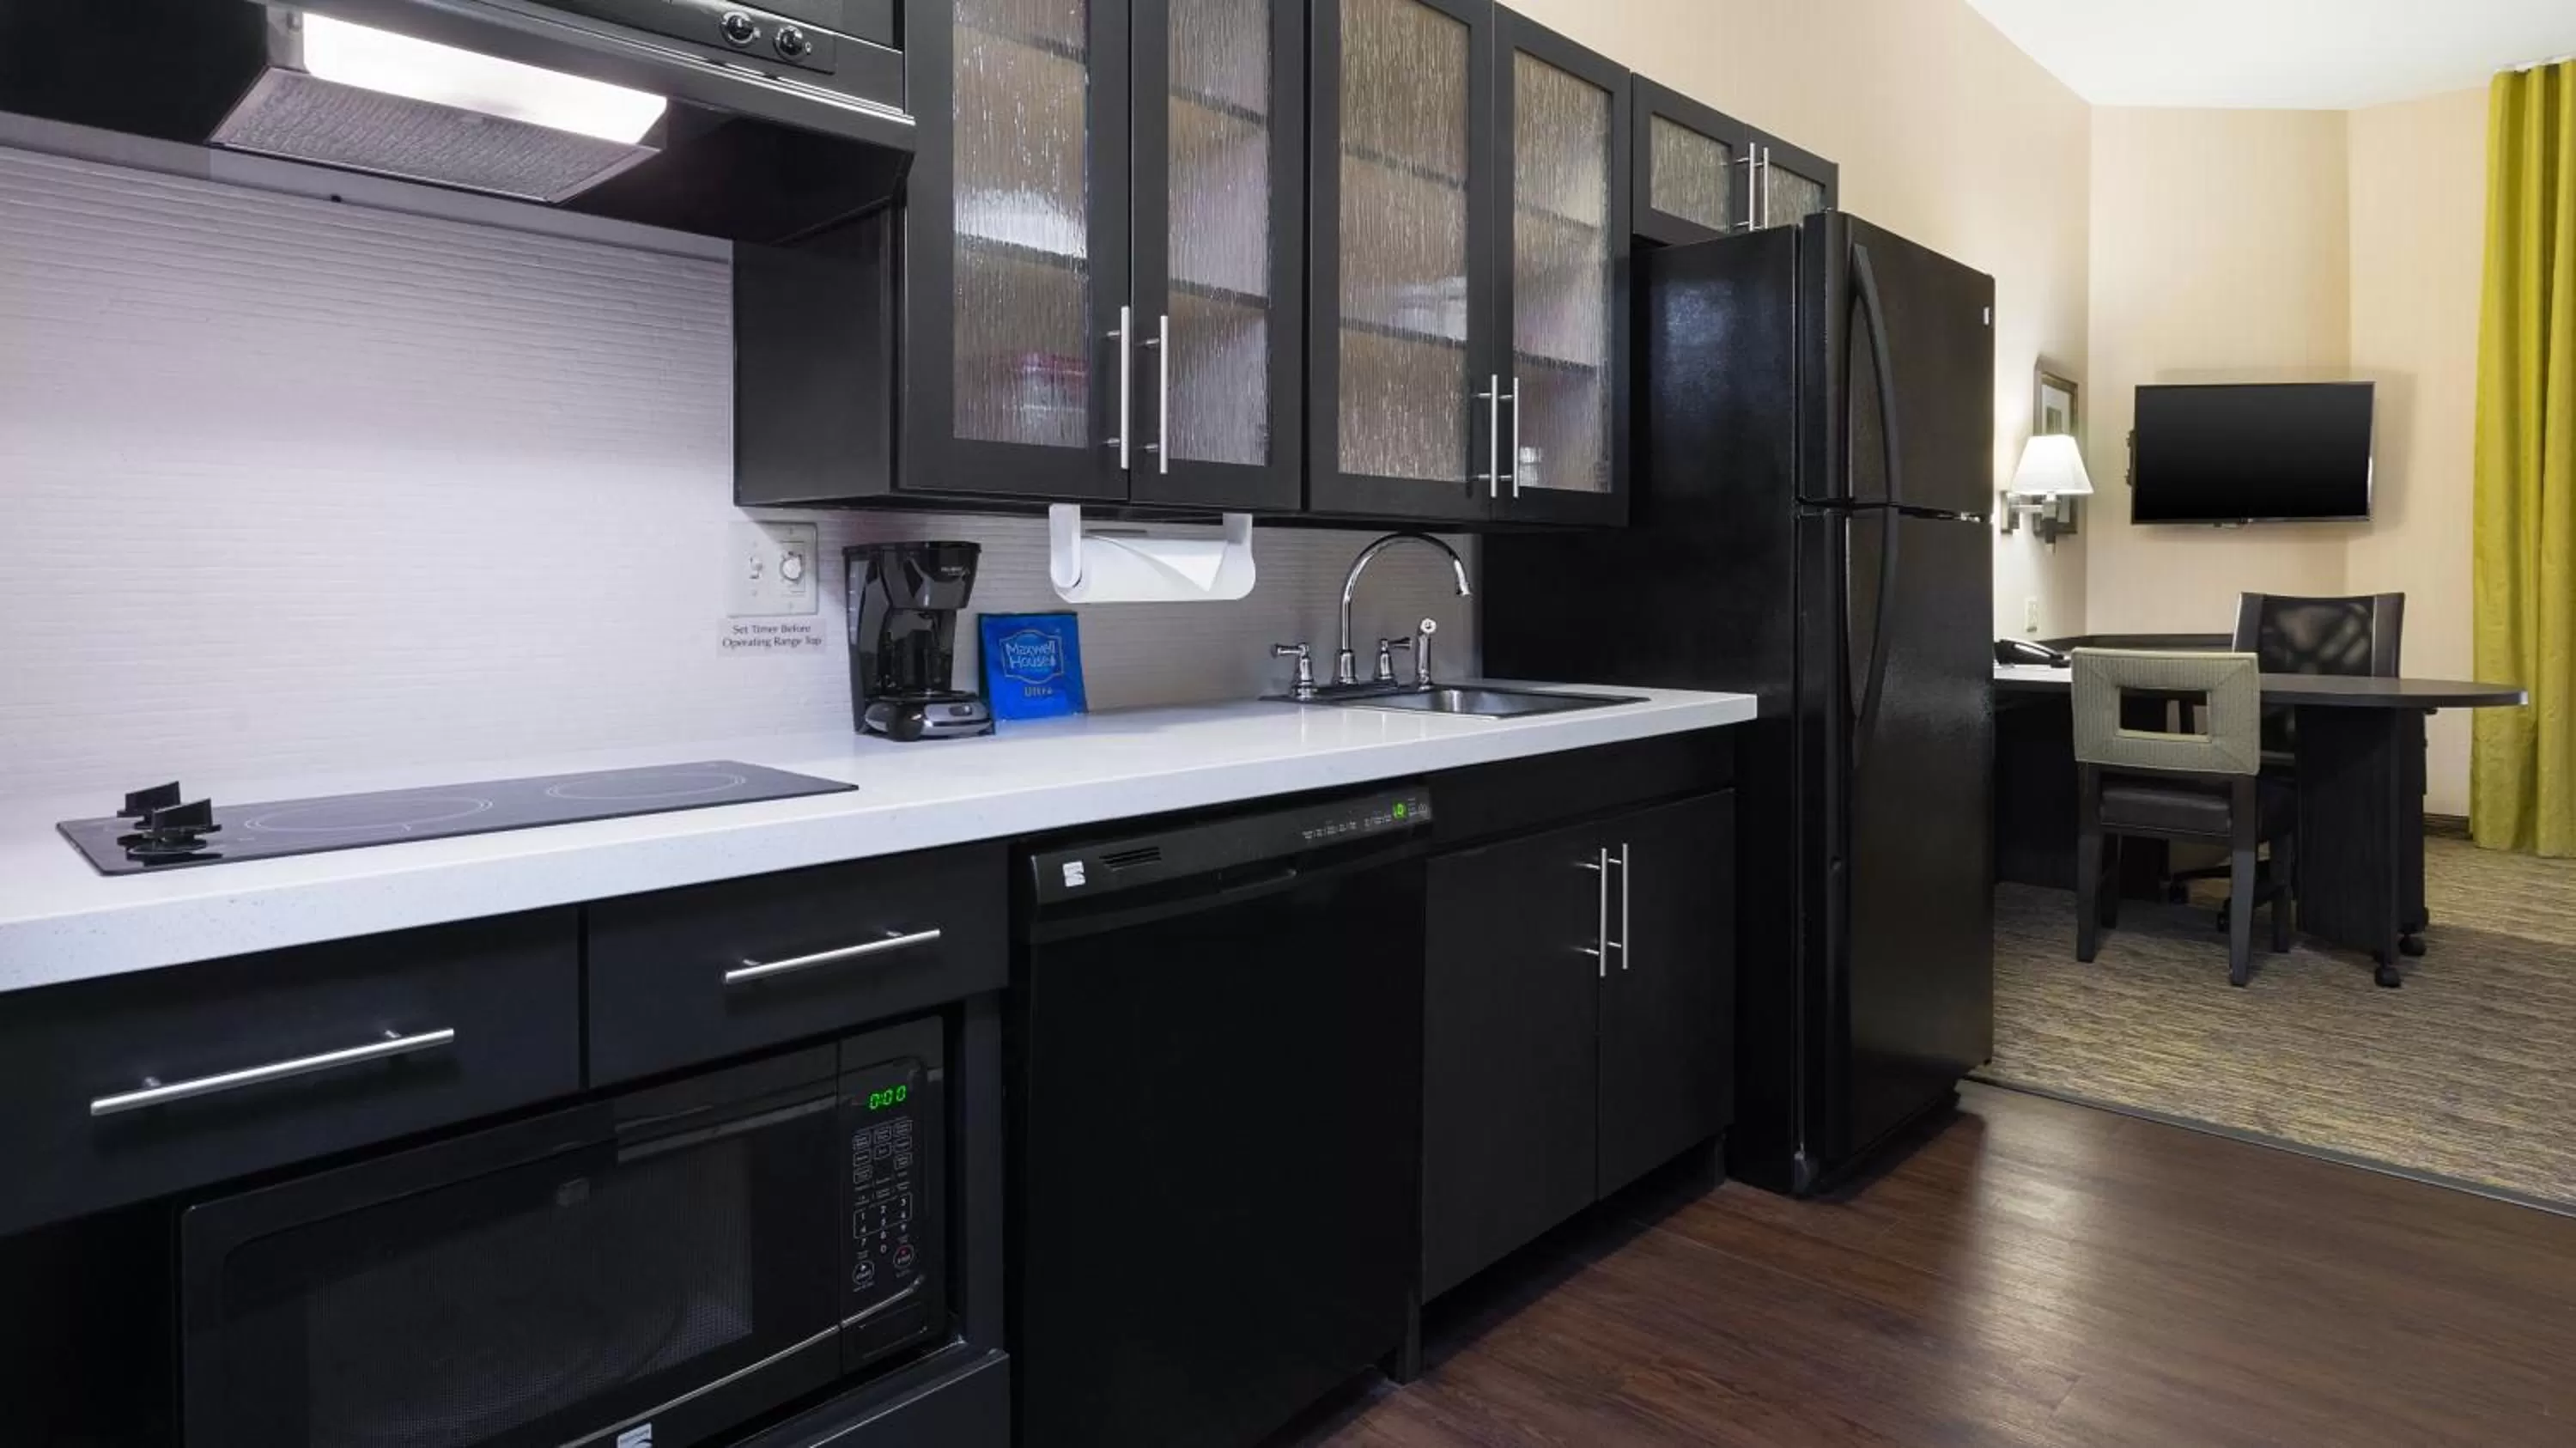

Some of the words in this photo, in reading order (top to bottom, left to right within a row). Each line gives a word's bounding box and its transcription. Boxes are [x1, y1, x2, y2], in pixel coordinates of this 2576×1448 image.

[732, 625, 748, 635] Set
[752, 625, 778, 634] Timer
[781, 624, 811, 634] Before
[722, 637, 771, 649] Operating
[774, 636, 803, 648] Range
[1005, 640, 1055, 657] Maxwell
[1009, 655, 1052, 669] House
